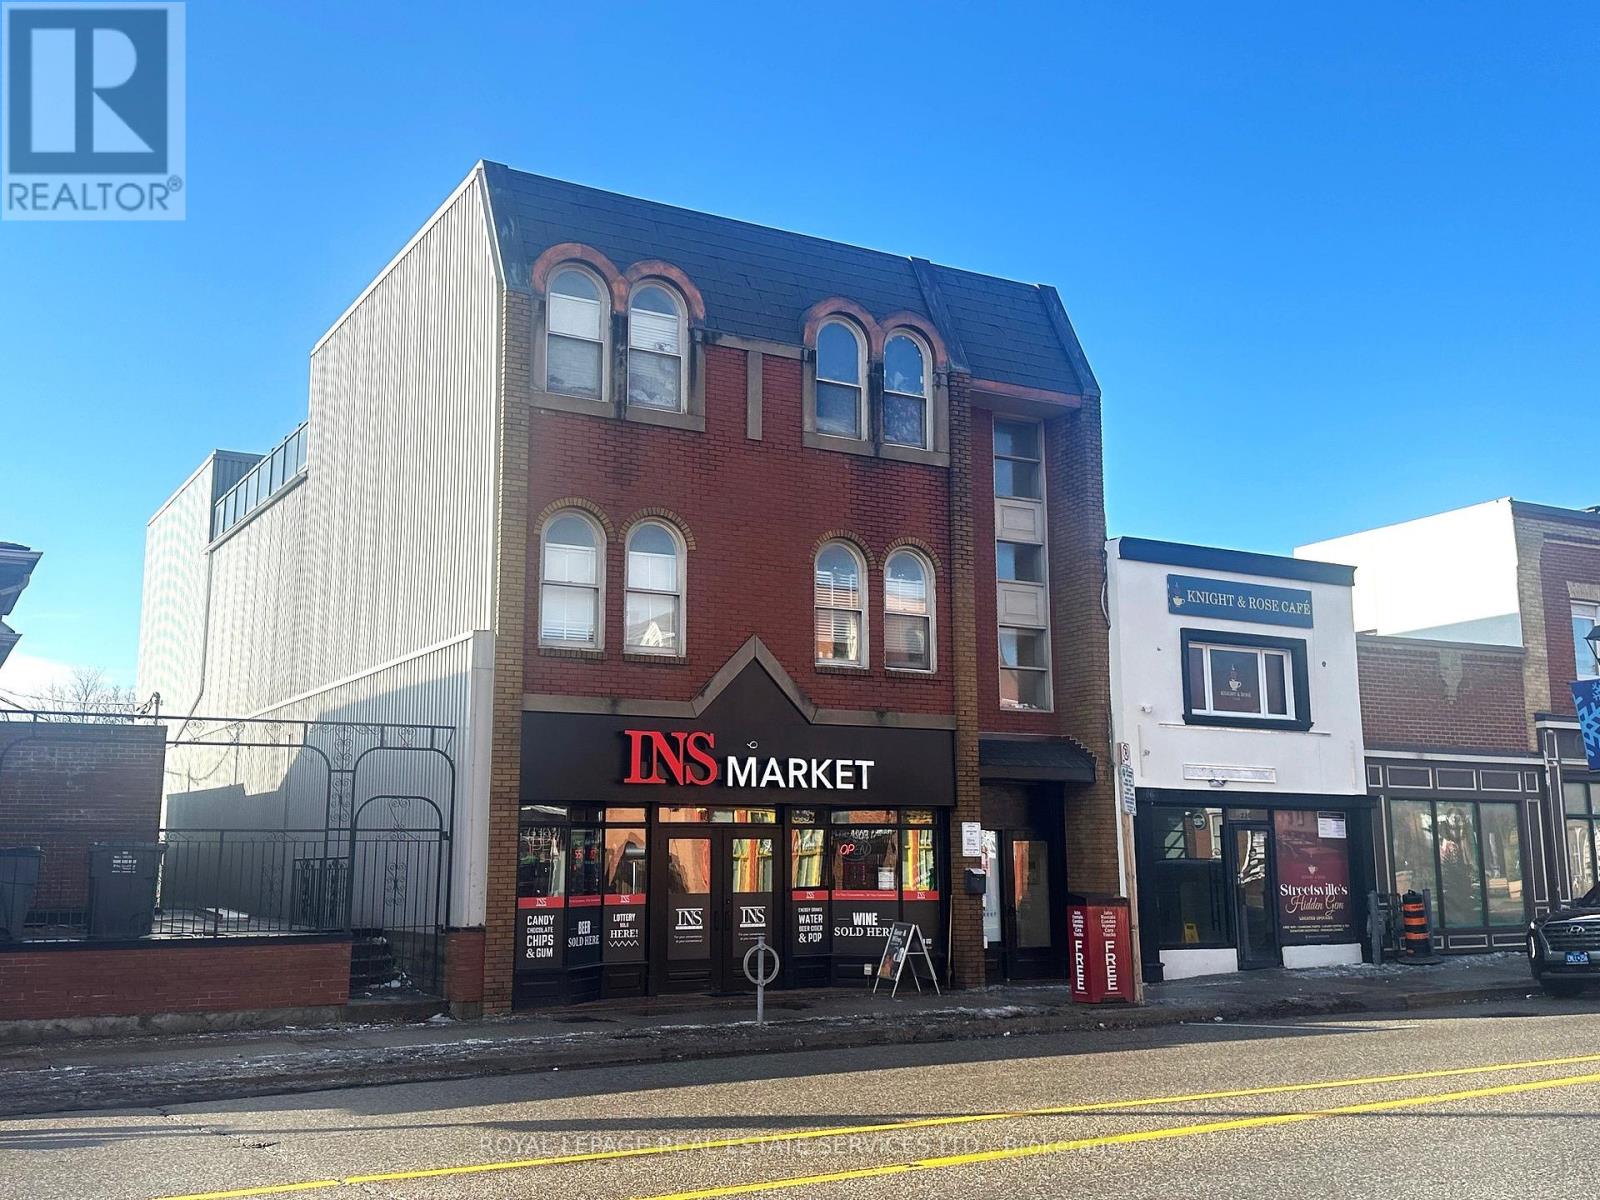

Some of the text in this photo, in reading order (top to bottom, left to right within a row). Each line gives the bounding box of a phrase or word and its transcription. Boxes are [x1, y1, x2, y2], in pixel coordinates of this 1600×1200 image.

[1187, 589, 1311, 615] KNIGHT & ROSE CAFÉ
[624, 730, 875, 790] INS MARKET
[1280, 883, 1348, 896] Streetsville's
[1285, 894, 1344, 917] Hidden Gem
[527, 915, 555, 925] CANDY
[613, 913, 636, 922] LOTTERY
[676, 908, 703, 926] INS
[740, 907, 766, 924] INS
[799, 914, 823, 924] WATER
[853, 912, 878, 926] WINE
[527, 926, 553, 934] CHOCOLATE
[578, 921, 591, 935] BEER
[610, 929, 639, 938] HERE!
[834, 927, 864, 937] SOLD
[526, 934, 554, 947] CHIPS
[568, 935, 600, 948] SOLD HERE
[798, 932, 822, 943] & POP
[526, 947, 553, 958] & GUM
[1075, 940, 1085, 991] FREE
[1105, 940, 1118, 991] FREE
